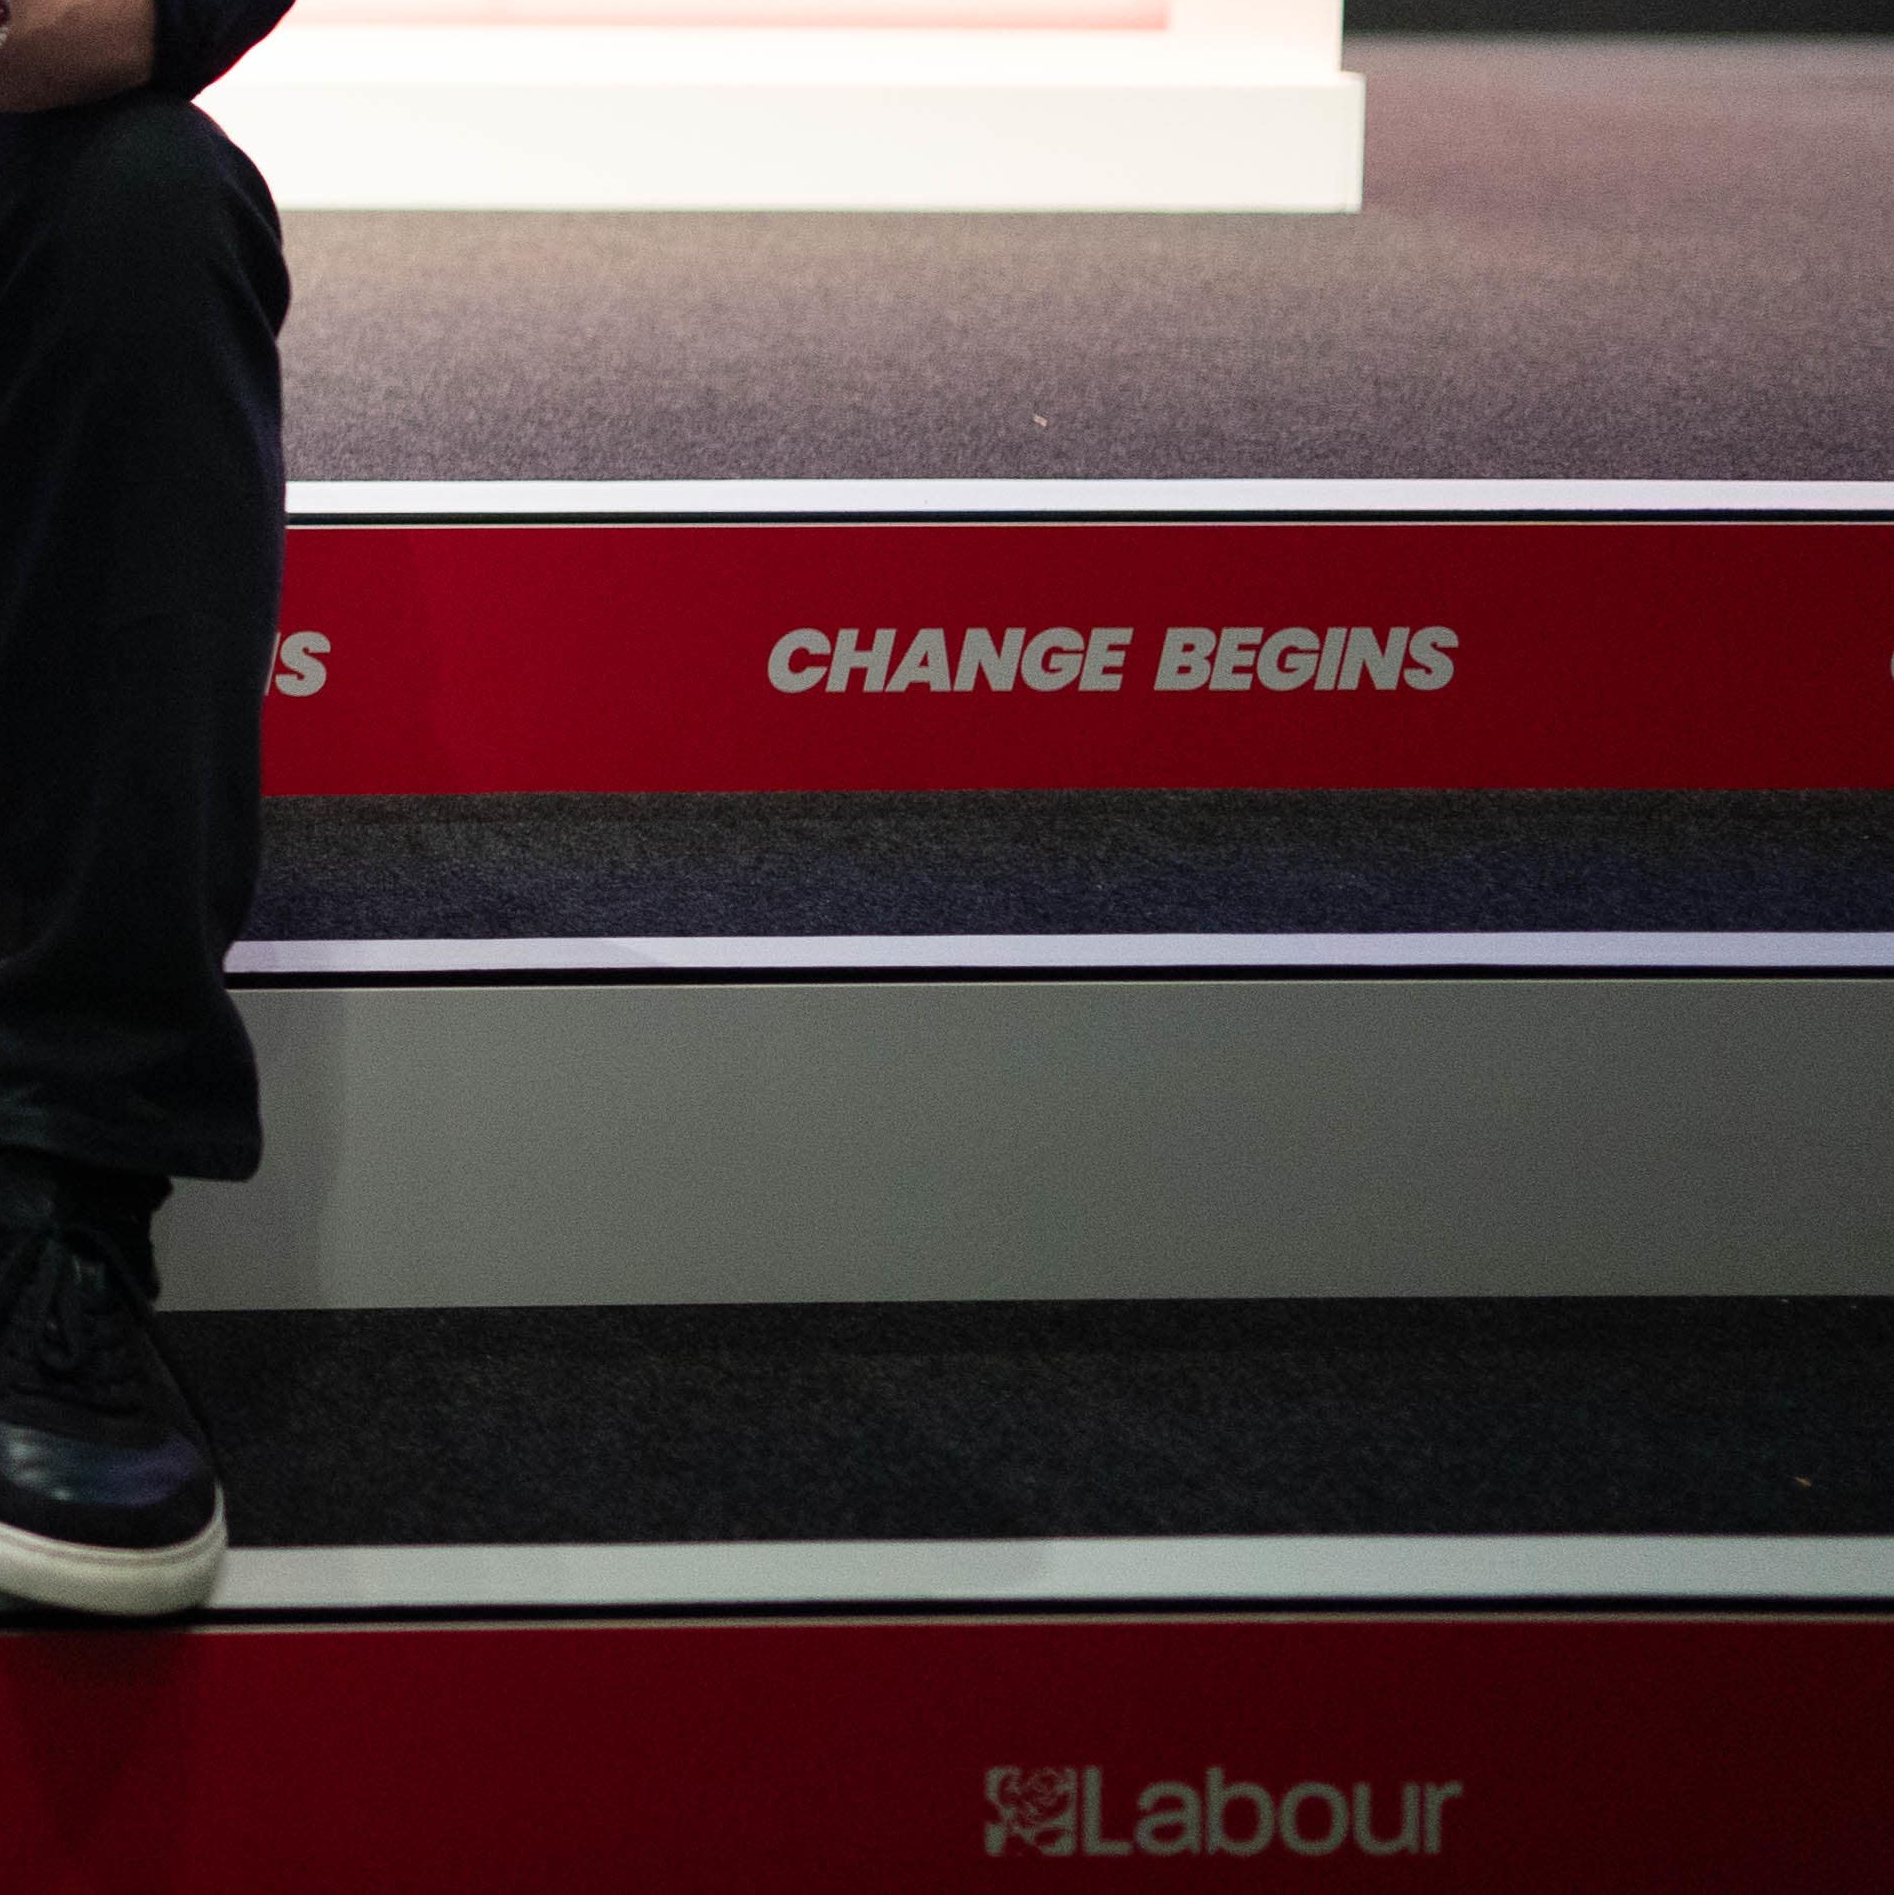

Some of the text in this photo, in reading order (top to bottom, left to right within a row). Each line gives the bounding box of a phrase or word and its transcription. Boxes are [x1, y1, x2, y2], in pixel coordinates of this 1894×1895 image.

[768, 626, 1459, 693] CHANGE BEGINS
[1082, 1765, 1463, 1856] Labour
